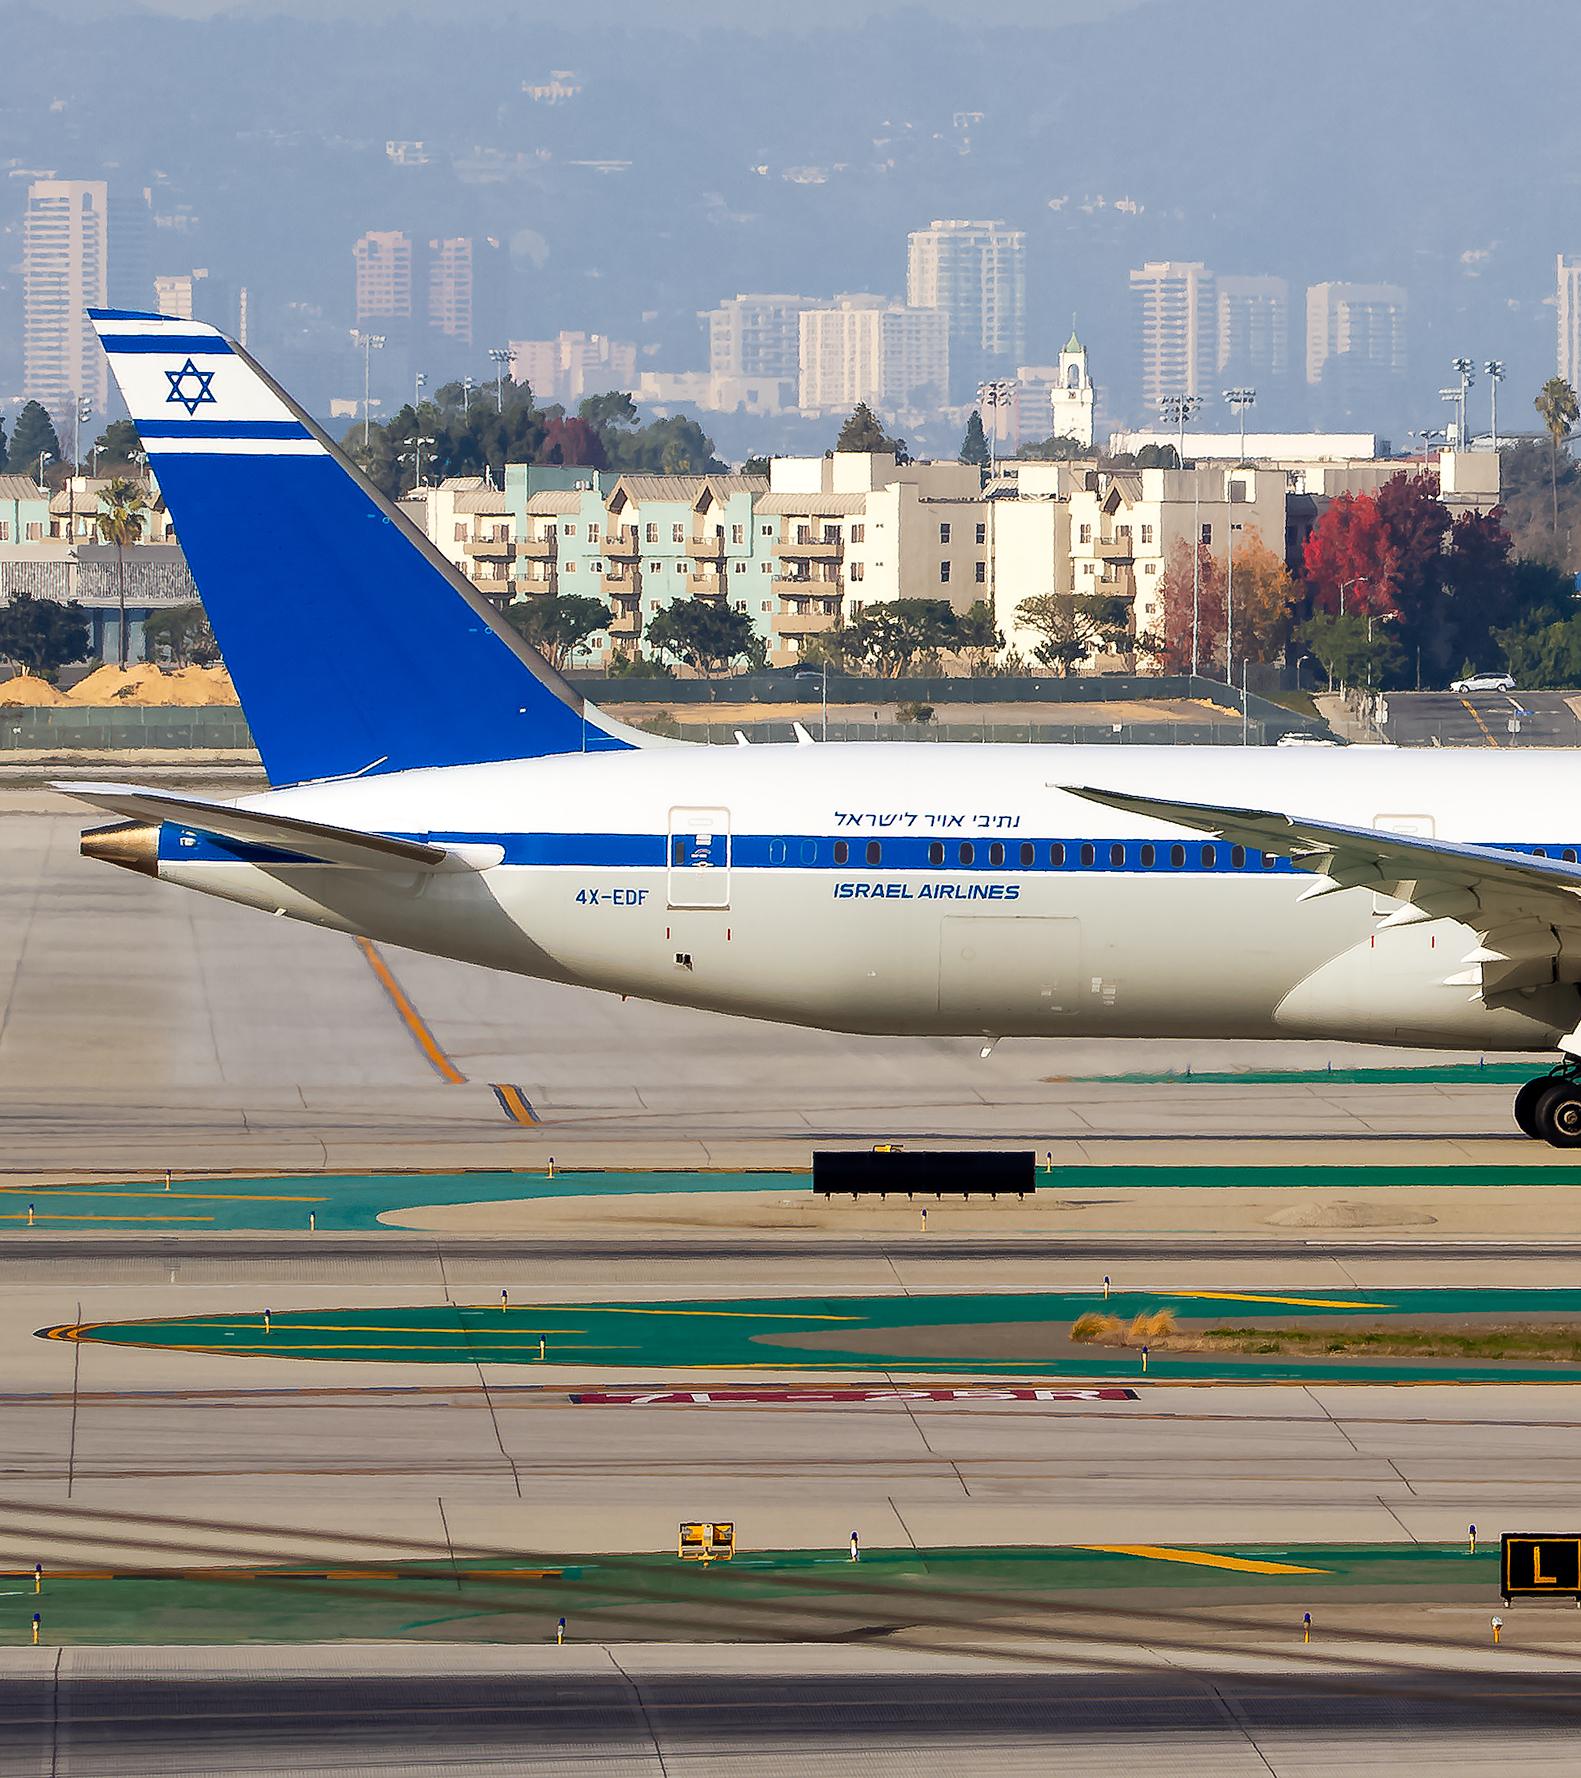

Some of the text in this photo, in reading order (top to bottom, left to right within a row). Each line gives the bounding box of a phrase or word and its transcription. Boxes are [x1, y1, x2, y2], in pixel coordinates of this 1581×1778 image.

[834, 811, 1021, 828] נתיבי אויר לישראל
[575, 888, 650, 906] 4X-EDF
[833, 882, 1021, 900] ISRAEL AIRLINES
[1533, 1545, 1557, 1584] L
